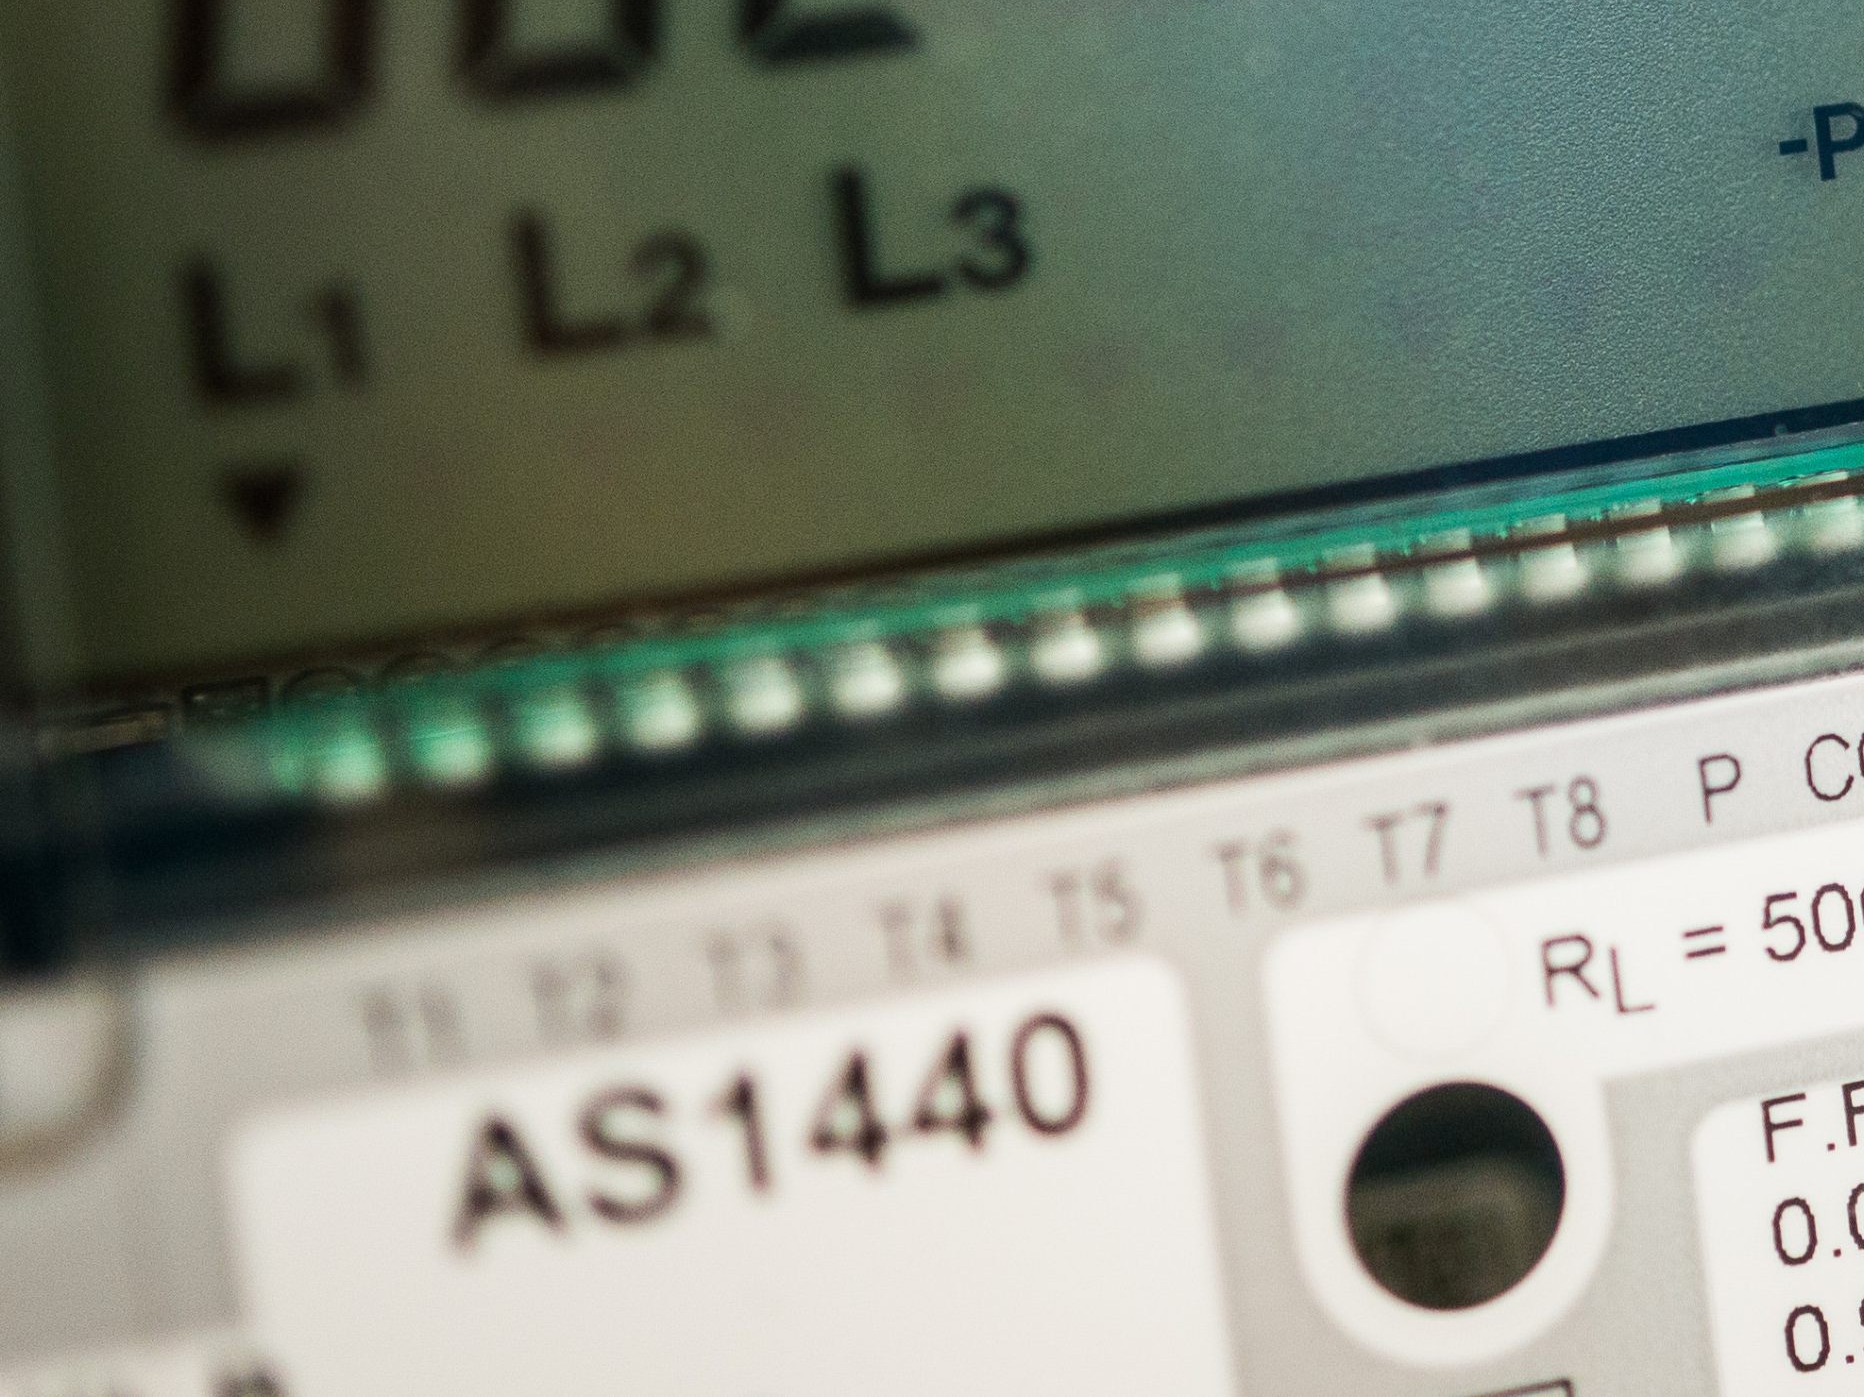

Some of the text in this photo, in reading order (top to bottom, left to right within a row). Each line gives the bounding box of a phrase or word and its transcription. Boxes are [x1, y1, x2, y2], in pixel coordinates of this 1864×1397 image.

[830, 164, 1034, 309] L3
[1044, 857, 1143, 950] T5
[1211, 828, 1306, 920] T6
[1364, 801, 1451, 886] T7
[1513, 774, 1609, 859] T8
[1697, 752, 1743, 825] P
[1540, 932, 1656, 1017] RL
[449, 1008, 1092, 1258] AS1440
